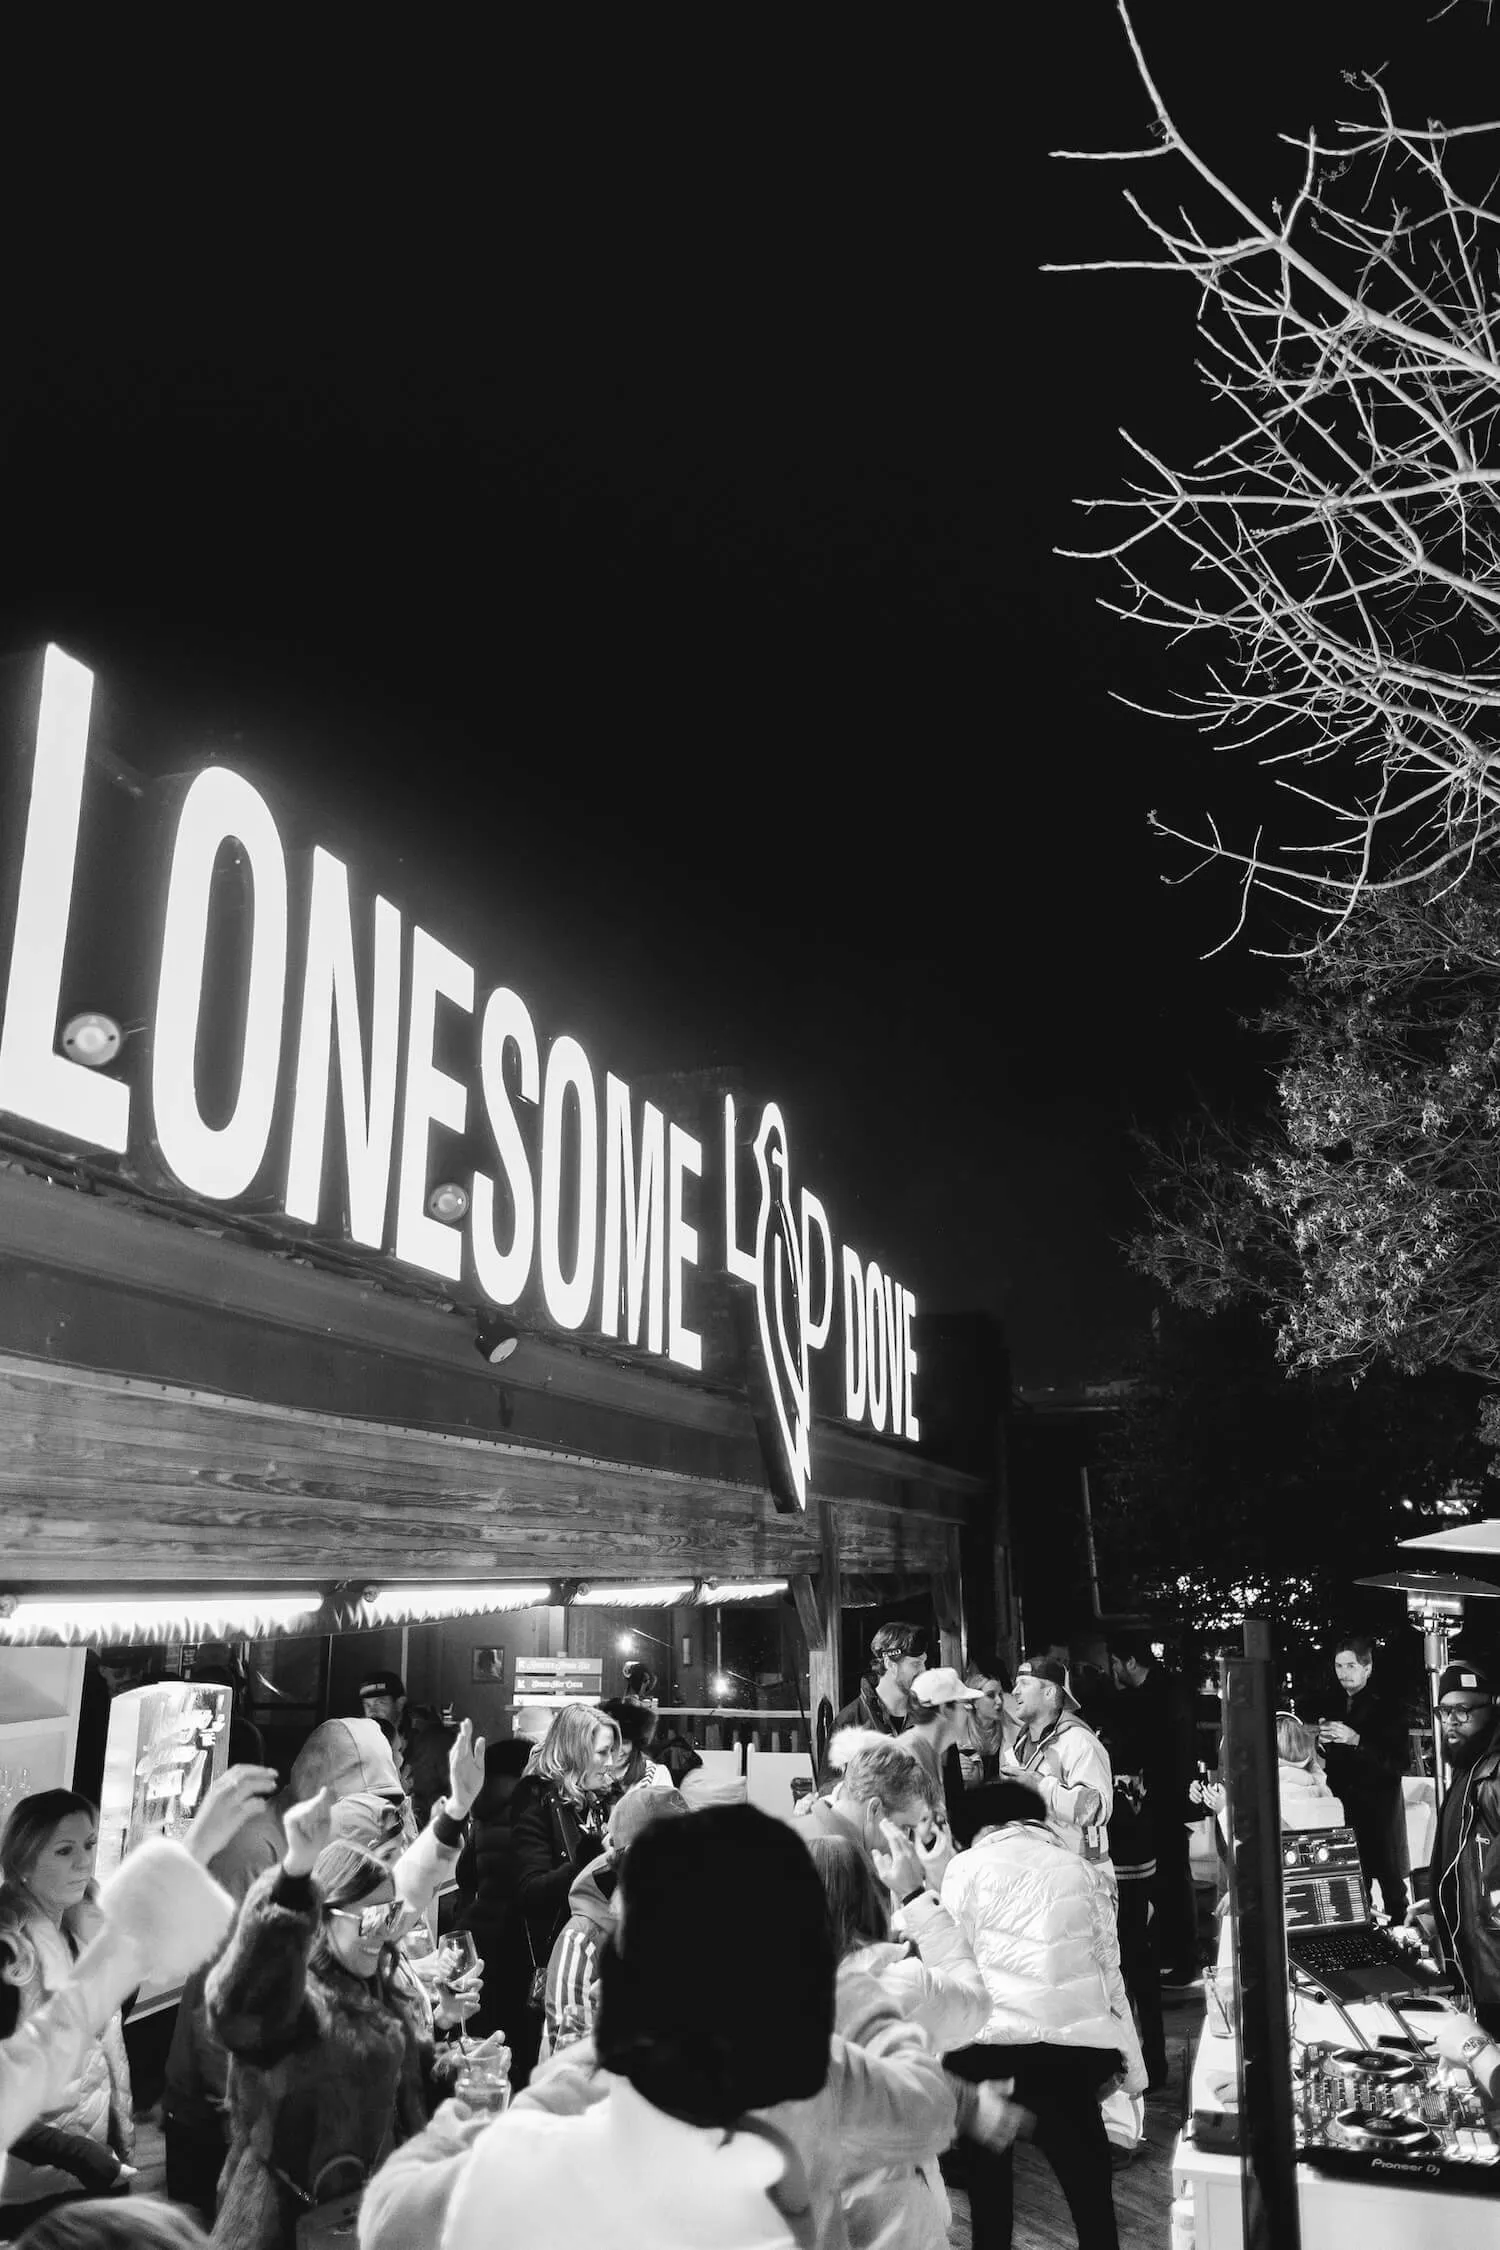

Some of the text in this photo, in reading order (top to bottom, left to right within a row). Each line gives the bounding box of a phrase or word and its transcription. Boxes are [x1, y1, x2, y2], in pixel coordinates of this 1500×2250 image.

[0, 642, 703, 1371] LONESOME
[842, 1244, 920, 1443] DOVE
[1371, 2158, 1423, 2172] Pioneer
